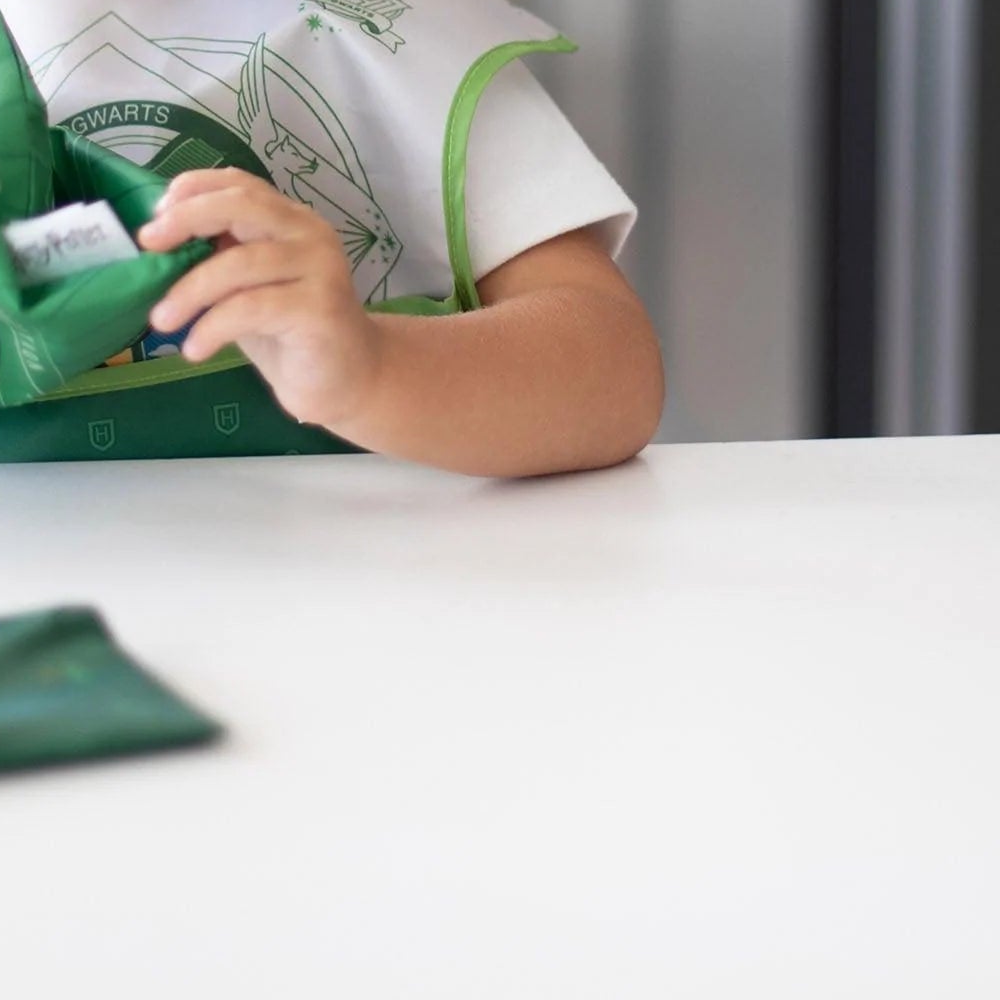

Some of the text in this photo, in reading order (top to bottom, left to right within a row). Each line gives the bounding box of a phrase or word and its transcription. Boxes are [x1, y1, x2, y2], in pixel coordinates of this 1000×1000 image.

[70, 103, 170, 135] GWARTS
[220, 409, 235, 427] H
[95, 425, 109, 442] H
